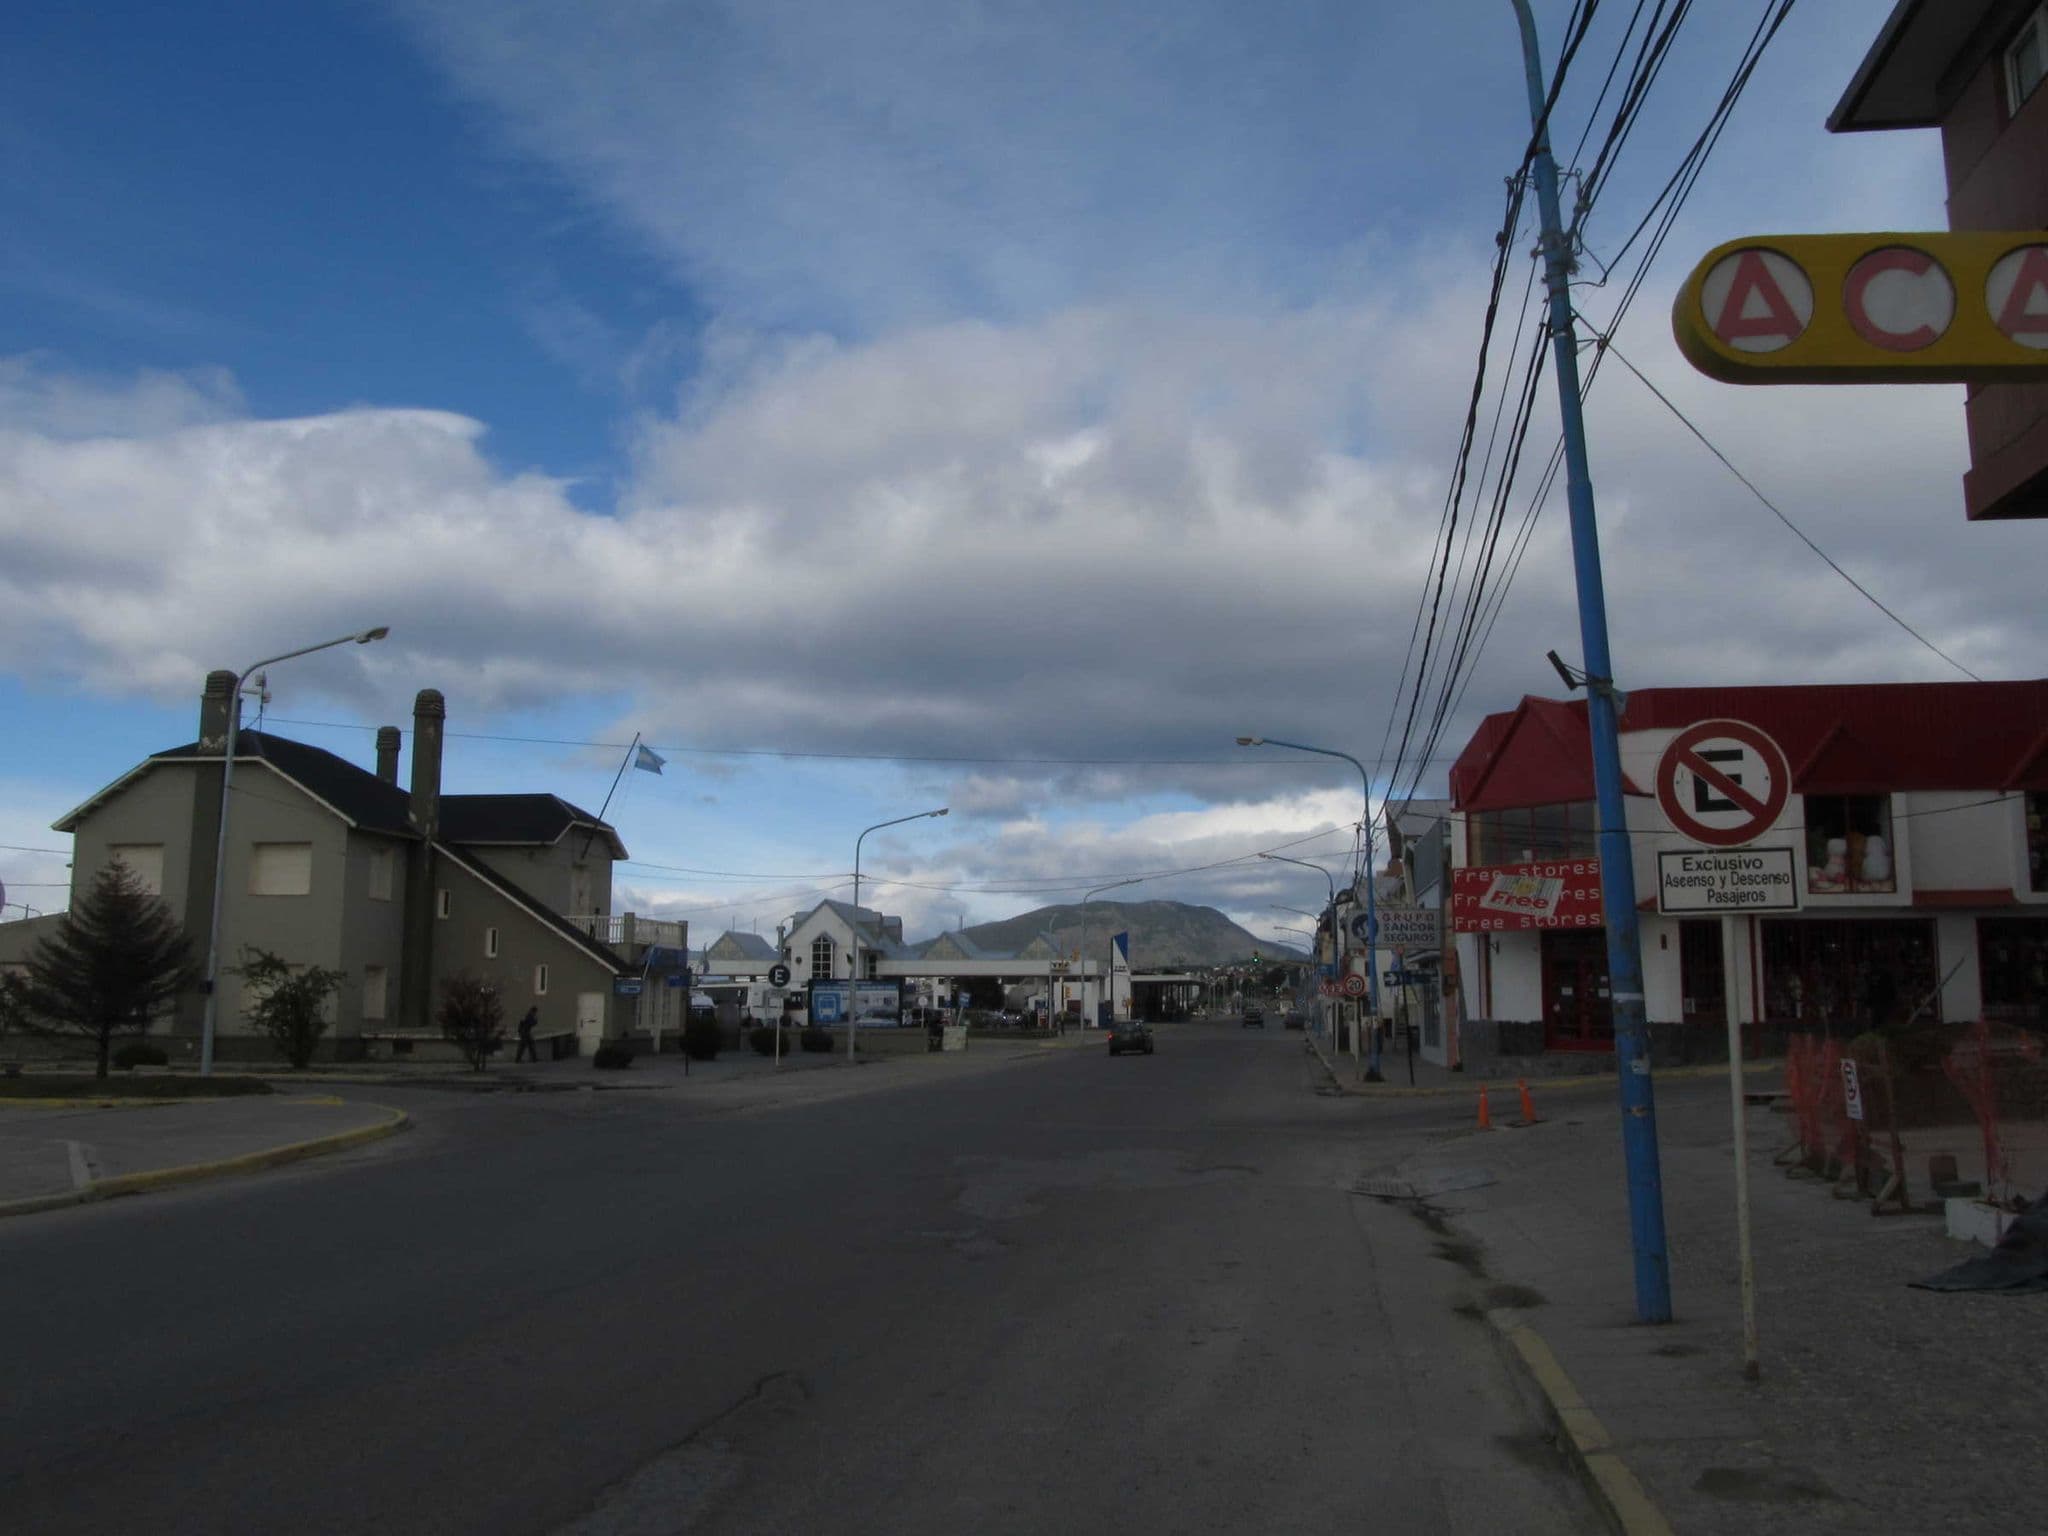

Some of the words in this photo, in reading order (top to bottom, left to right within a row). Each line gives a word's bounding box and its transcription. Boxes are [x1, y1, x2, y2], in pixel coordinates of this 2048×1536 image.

[1682, 855, 1763, 871] Exclusivo
[1453, 869, 1502, 884] Free
[1519, 862, 1600, 878] stores
[1665, 873, 1715, 887] Ascenso
[1720, 875, 1726, 889] y
[1731, 871, 1790, 886] Descenso
[1491, 889, 1549, 909] Free
[1707, 889, 1766, 905] Pasajeros
[1382, 912, 1434, 922] GRUPO
[1455, 915, 1505, 930] Free
[1520, 913, 1600, 928] stores
[1383, 923, 1435, 932] SANCOR
[1383, 933, 1435, 942] SEGUROS
[774, 969, 785, 983] E
